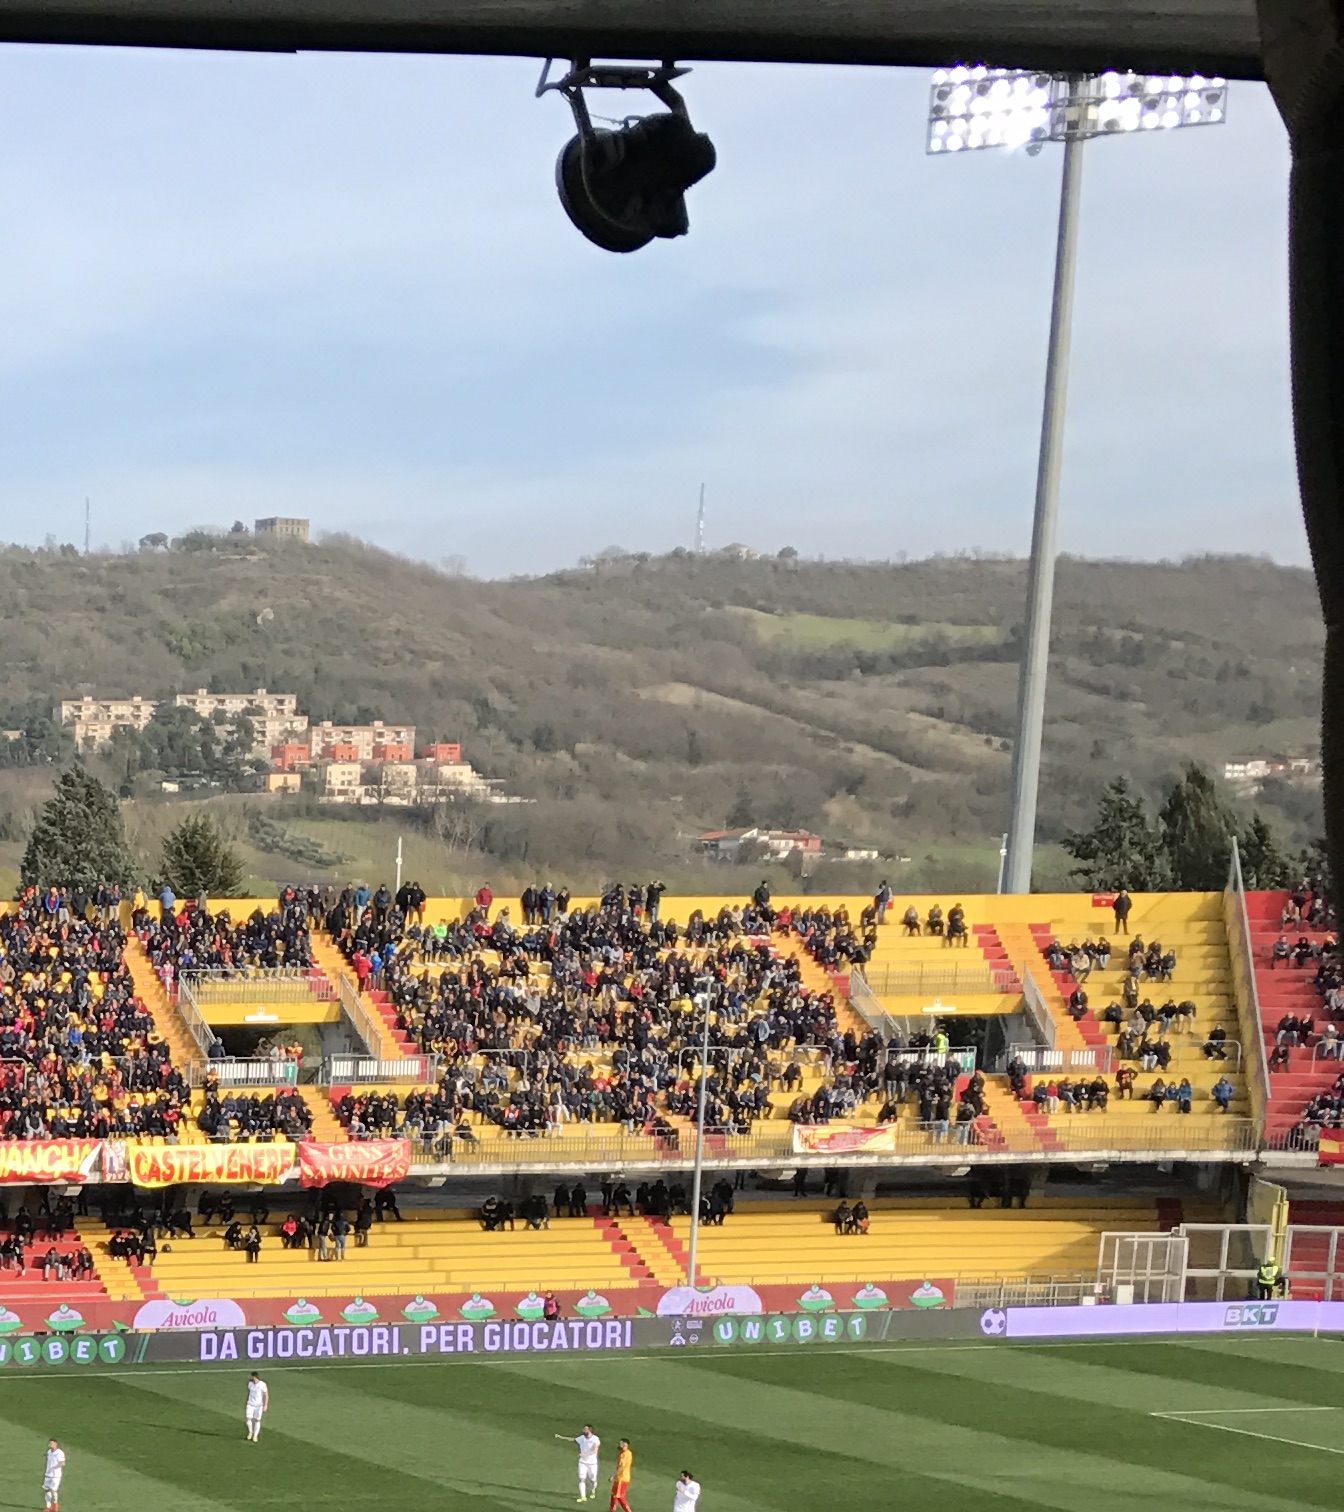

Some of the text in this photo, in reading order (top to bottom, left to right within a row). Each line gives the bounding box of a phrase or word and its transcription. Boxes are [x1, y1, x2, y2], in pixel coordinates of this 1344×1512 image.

[329, 1144, 383, 1160] GENS
[303, 1162, 407, 1180] SAMNITES
[682, 1296, 735, 1314] Avicola
[1225, 1305, 1279, 1324] BKT
[161, 1306, 217, 1327] Avicola
[717, 1316, 864, 1340] UNIBET
[200, 1320, 632, 1361] DA GIOCATORI. PER GIOCATORI
